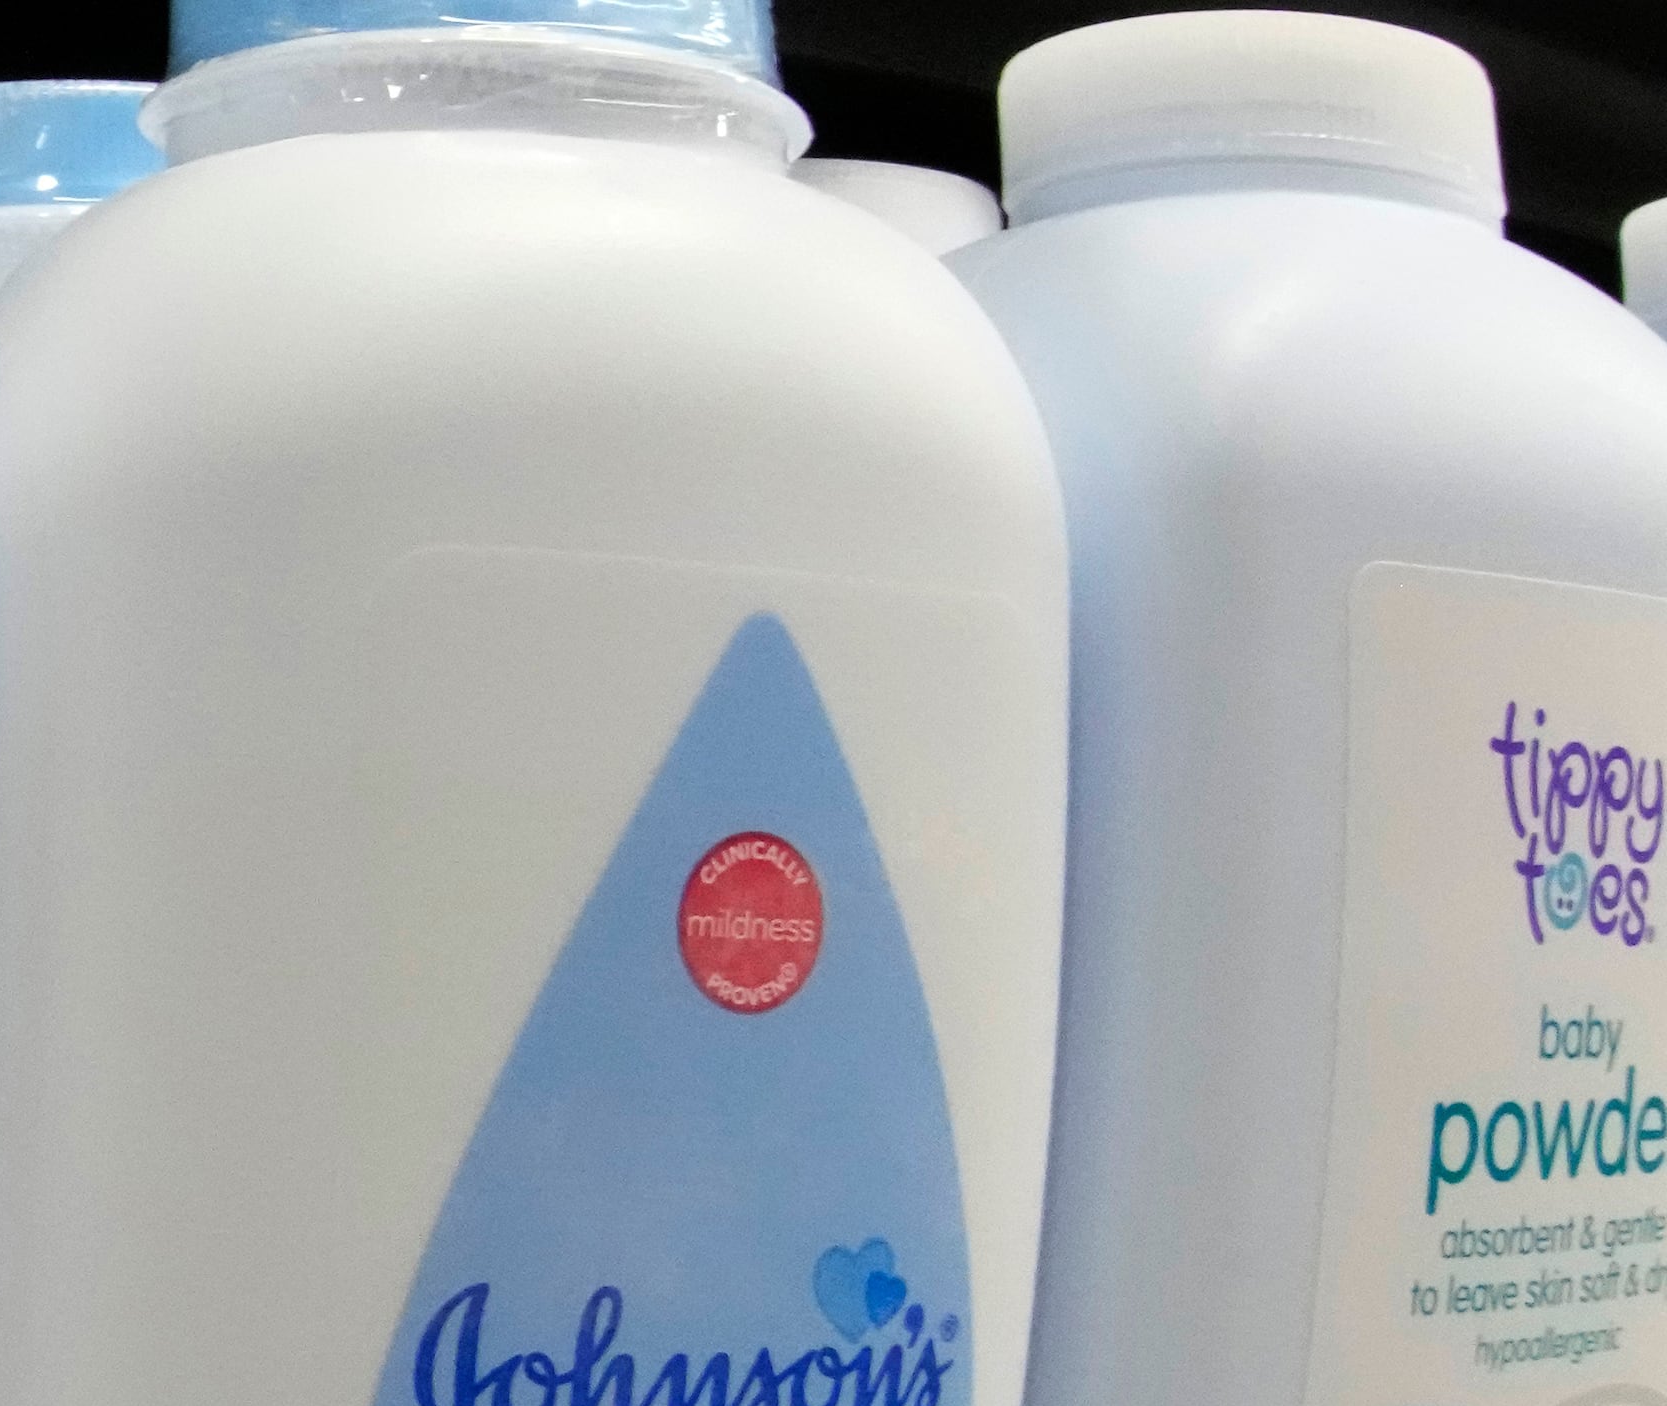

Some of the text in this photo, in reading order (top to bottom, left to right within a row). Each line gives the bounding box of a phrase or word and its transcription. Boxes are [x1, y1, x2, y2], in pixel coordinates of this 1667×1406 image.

[1489, 701, 1663, 864] tippy
[700, 841, 809, 885] CLINICALLY
[686, 908, 815, 942] mildness
[1540, 1004, 1622, 1072] baby
[1442, 1216, 1574, 1258] absorbent
[1406, 1274, 1438, 1316] to
[1447, 1274, 1517, 1315] leave
[1525, 1268, 1572, 1308] skin
